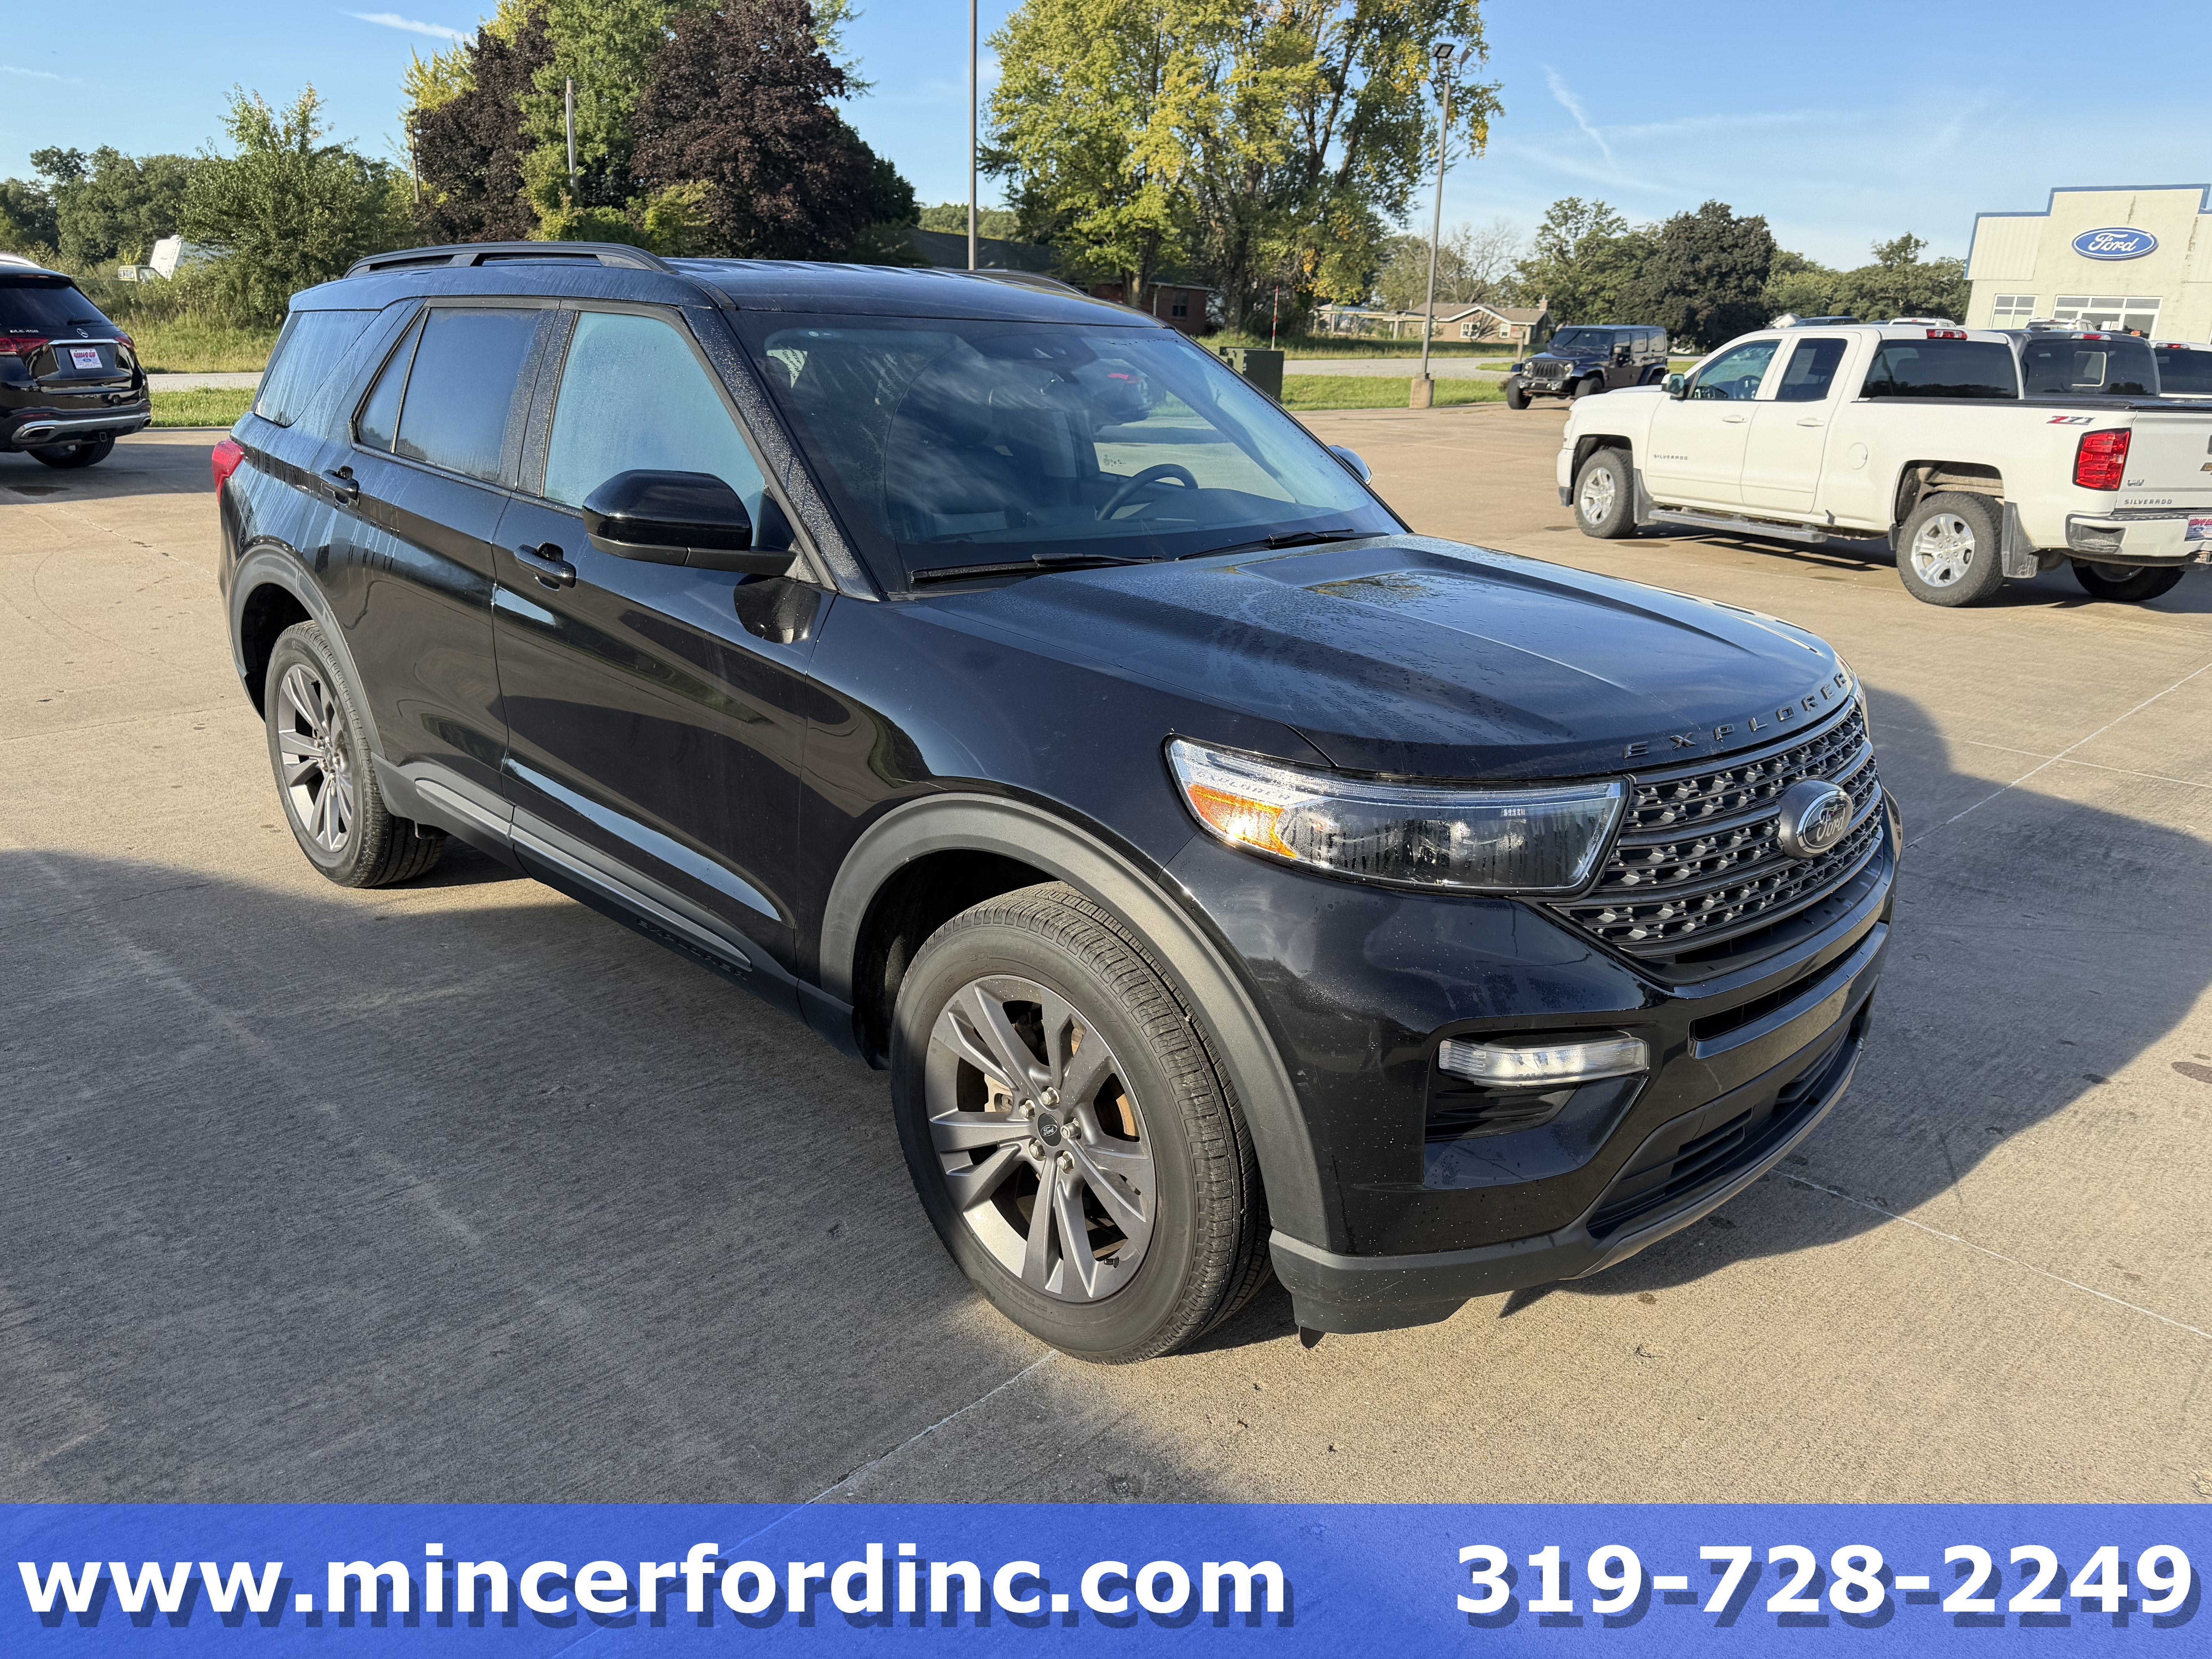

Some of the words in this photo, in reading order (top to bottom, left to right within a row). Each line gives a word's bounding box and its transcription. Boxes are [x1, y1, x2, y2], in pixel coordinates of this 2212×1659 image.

[2088, 232, 2140, 251] Ford
[2046, 416, 2096, 426] Z71
[1623, 672, 1847, 759] EXPLORER
[1816, 804, 1846, 842] Ford
[1043, 1126, 1054, 1135] Ford
